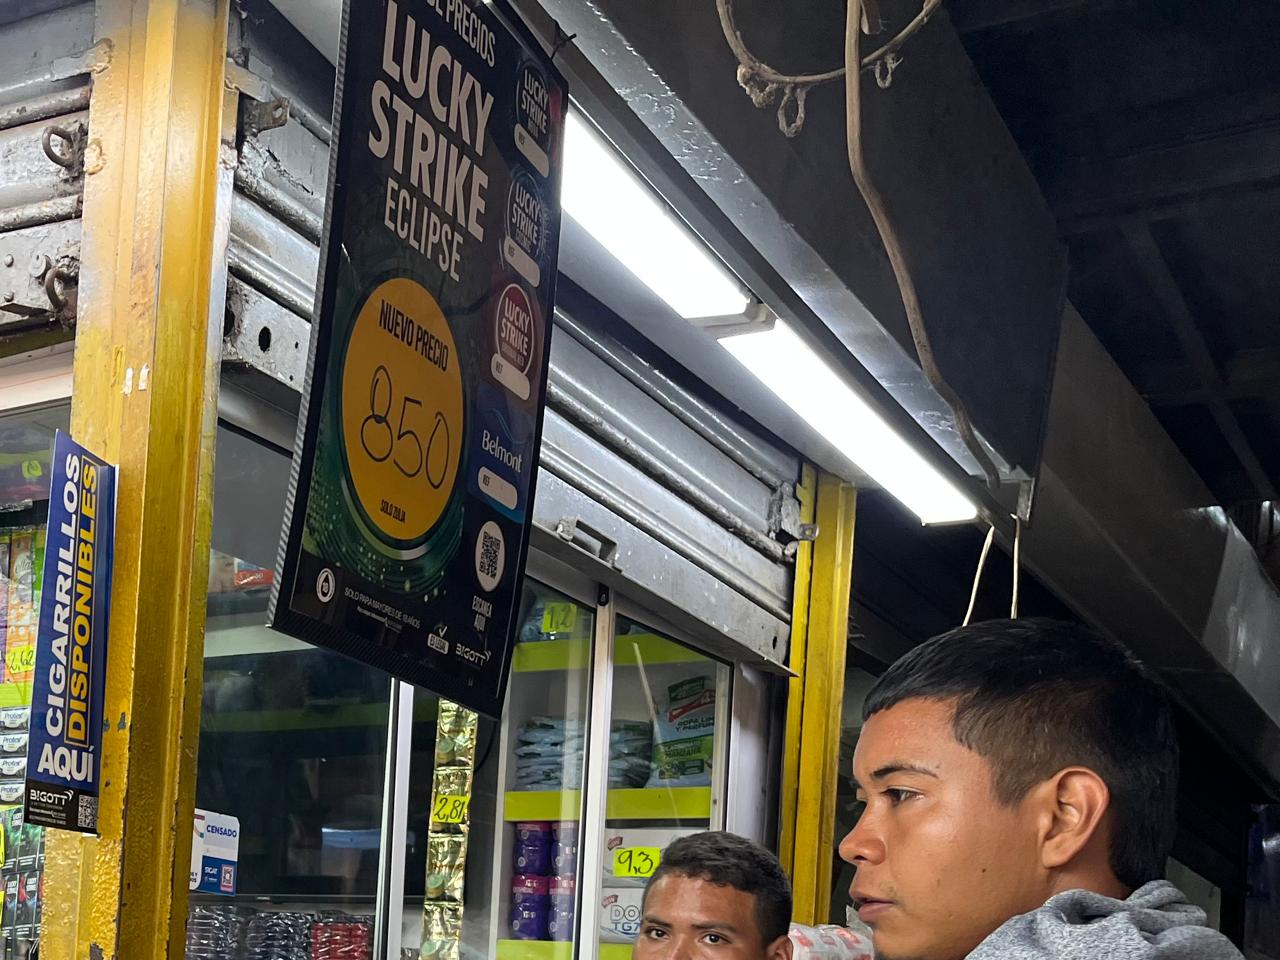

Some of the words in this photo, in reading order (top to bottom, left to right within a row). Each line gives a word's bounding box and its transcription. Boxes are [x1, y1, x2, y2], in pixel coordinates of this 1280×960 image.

[382, 0, 494, 157] LUCKY
[524, 69, 549, 111] LUCKY
[522, 89, 548, 135] STRIKE
[368, 79, 488, 242] STRIKE
[515, 182, 541, 222] LUCKY
[384, 177, 463, 281] ECLIPSE
[512, 203, 538, 245] STRIKE
[378, 299, 415, 349] NUEVO
[416, 329, 450, 373] PRECIO
[504, 297, 530, 333] LUCKY
[501, 318, 528, 356] STRIKE
[361, 365, 450, 490] 850
[482, 430, 523, 473] Belmont
[46, 453, 81, 738] CIGARRILLOS
[66, 463, 99, 744] DISPONIBLES
[37, 743, 95, 783] AQUÍ
[206, 824, 237, 838] CENSADO
[617, 850, 654, 875] 9,3
